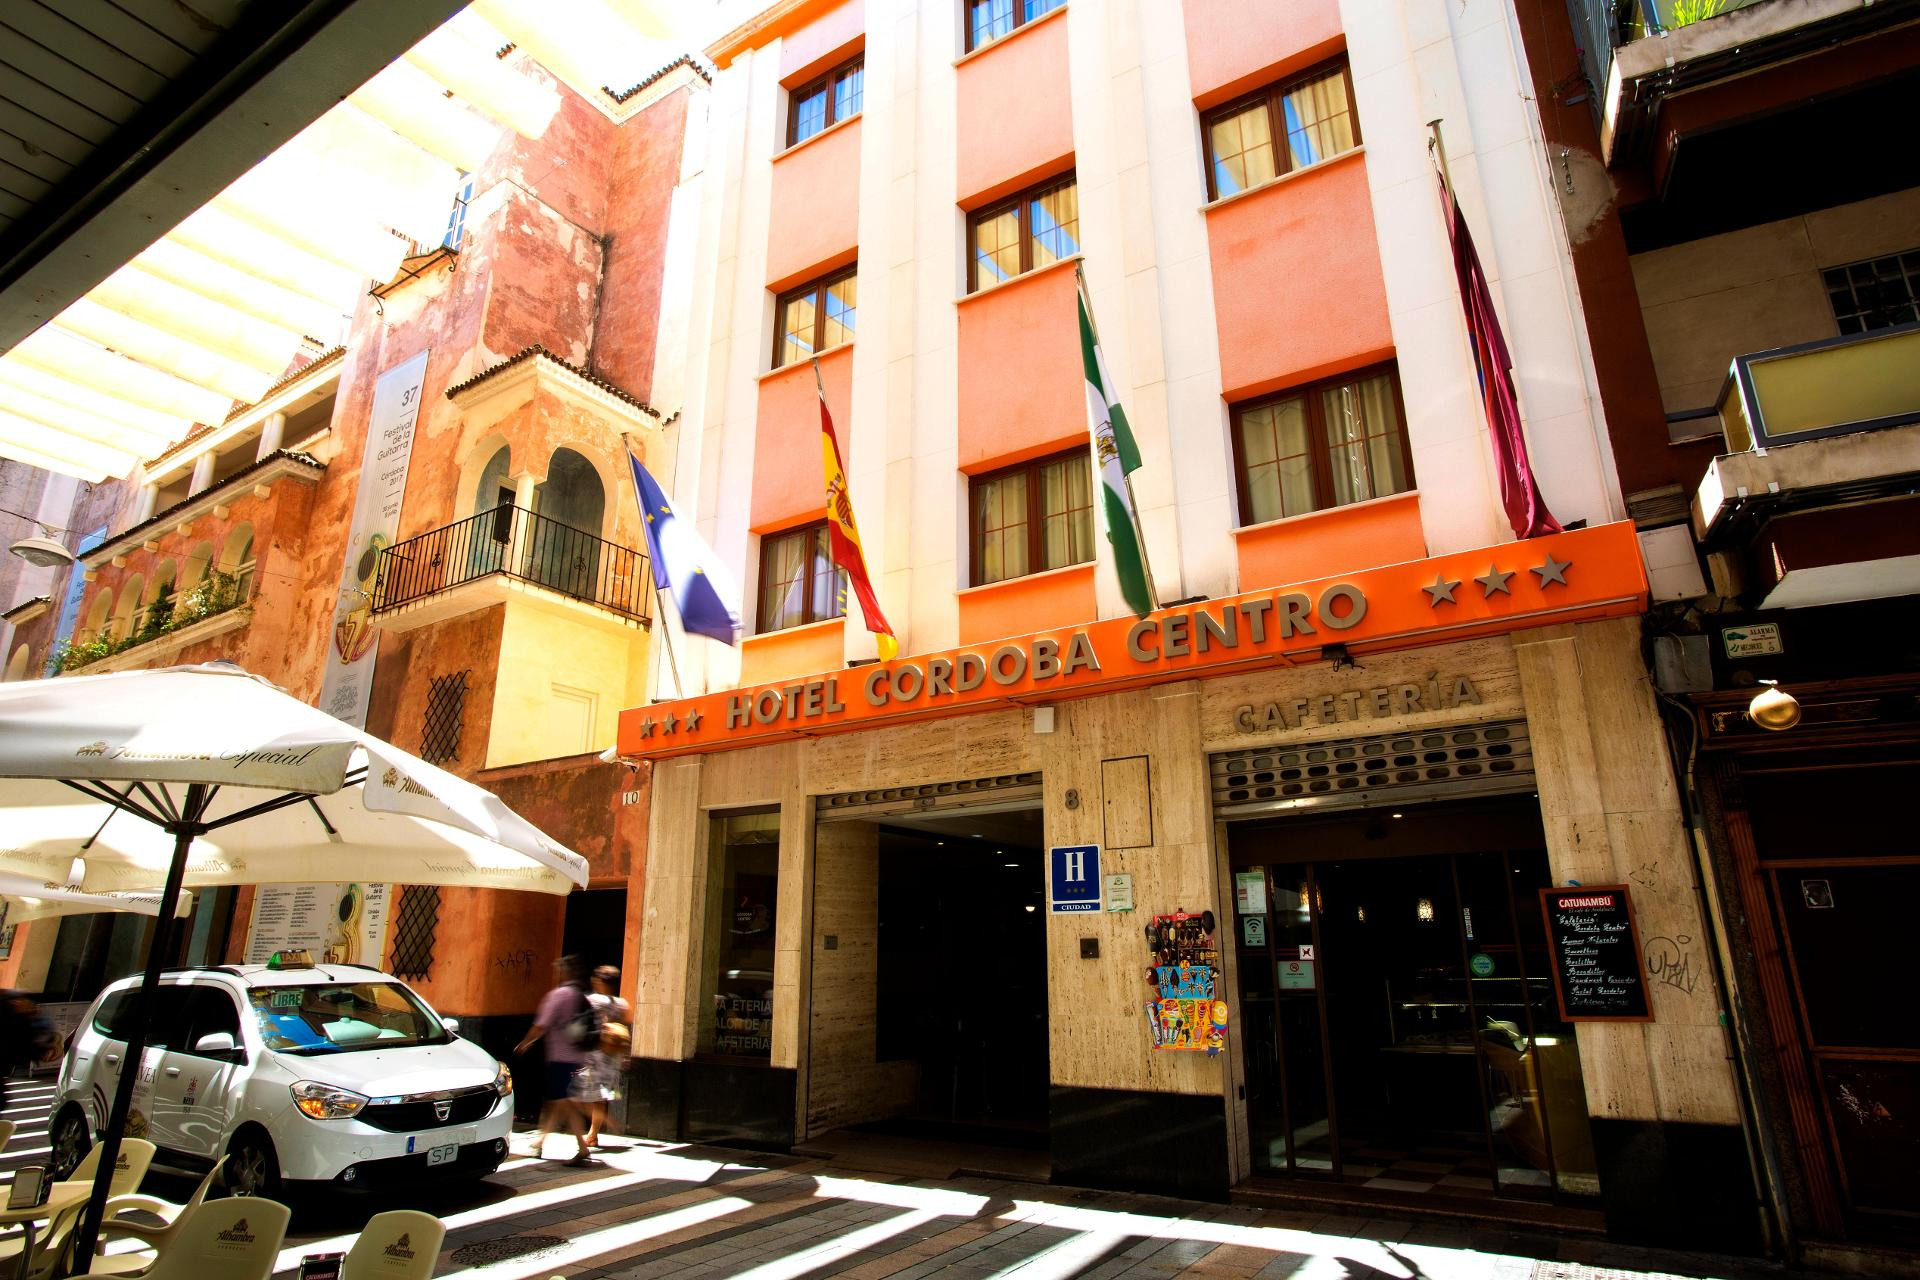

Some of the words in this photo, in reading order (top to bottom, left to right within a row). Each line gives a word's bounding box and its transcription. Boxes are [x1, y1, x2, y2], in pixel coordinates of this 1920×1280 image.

[402, 385, 419, 407] 37
[383, 418, 414, 441] Festival
[392, 432, 402, 445] de
[377, 441, 410, 461] Guitarra
[726, 678, 845, 730] HOTEL
[864, 632, 1101, 706] CORDOBA
[1126, 583, 1369, 664] CENTRO
[1234, 672, 1482, 734] CAFETERÍA
[625, 791, 639, 804] 10
[1065, 788, 1079, 811] 8
[1064, 851, 1086, 882] H
[1061, 902, 1092, 911] CIUDAD
[1559, 895, 1611, 908] CATUNAMBÚ
[272, 991, 303, 1006] LIBRE
[432, 1147, 454, 1163] SP
[214, 1229, 256, 1243] Alhambra
